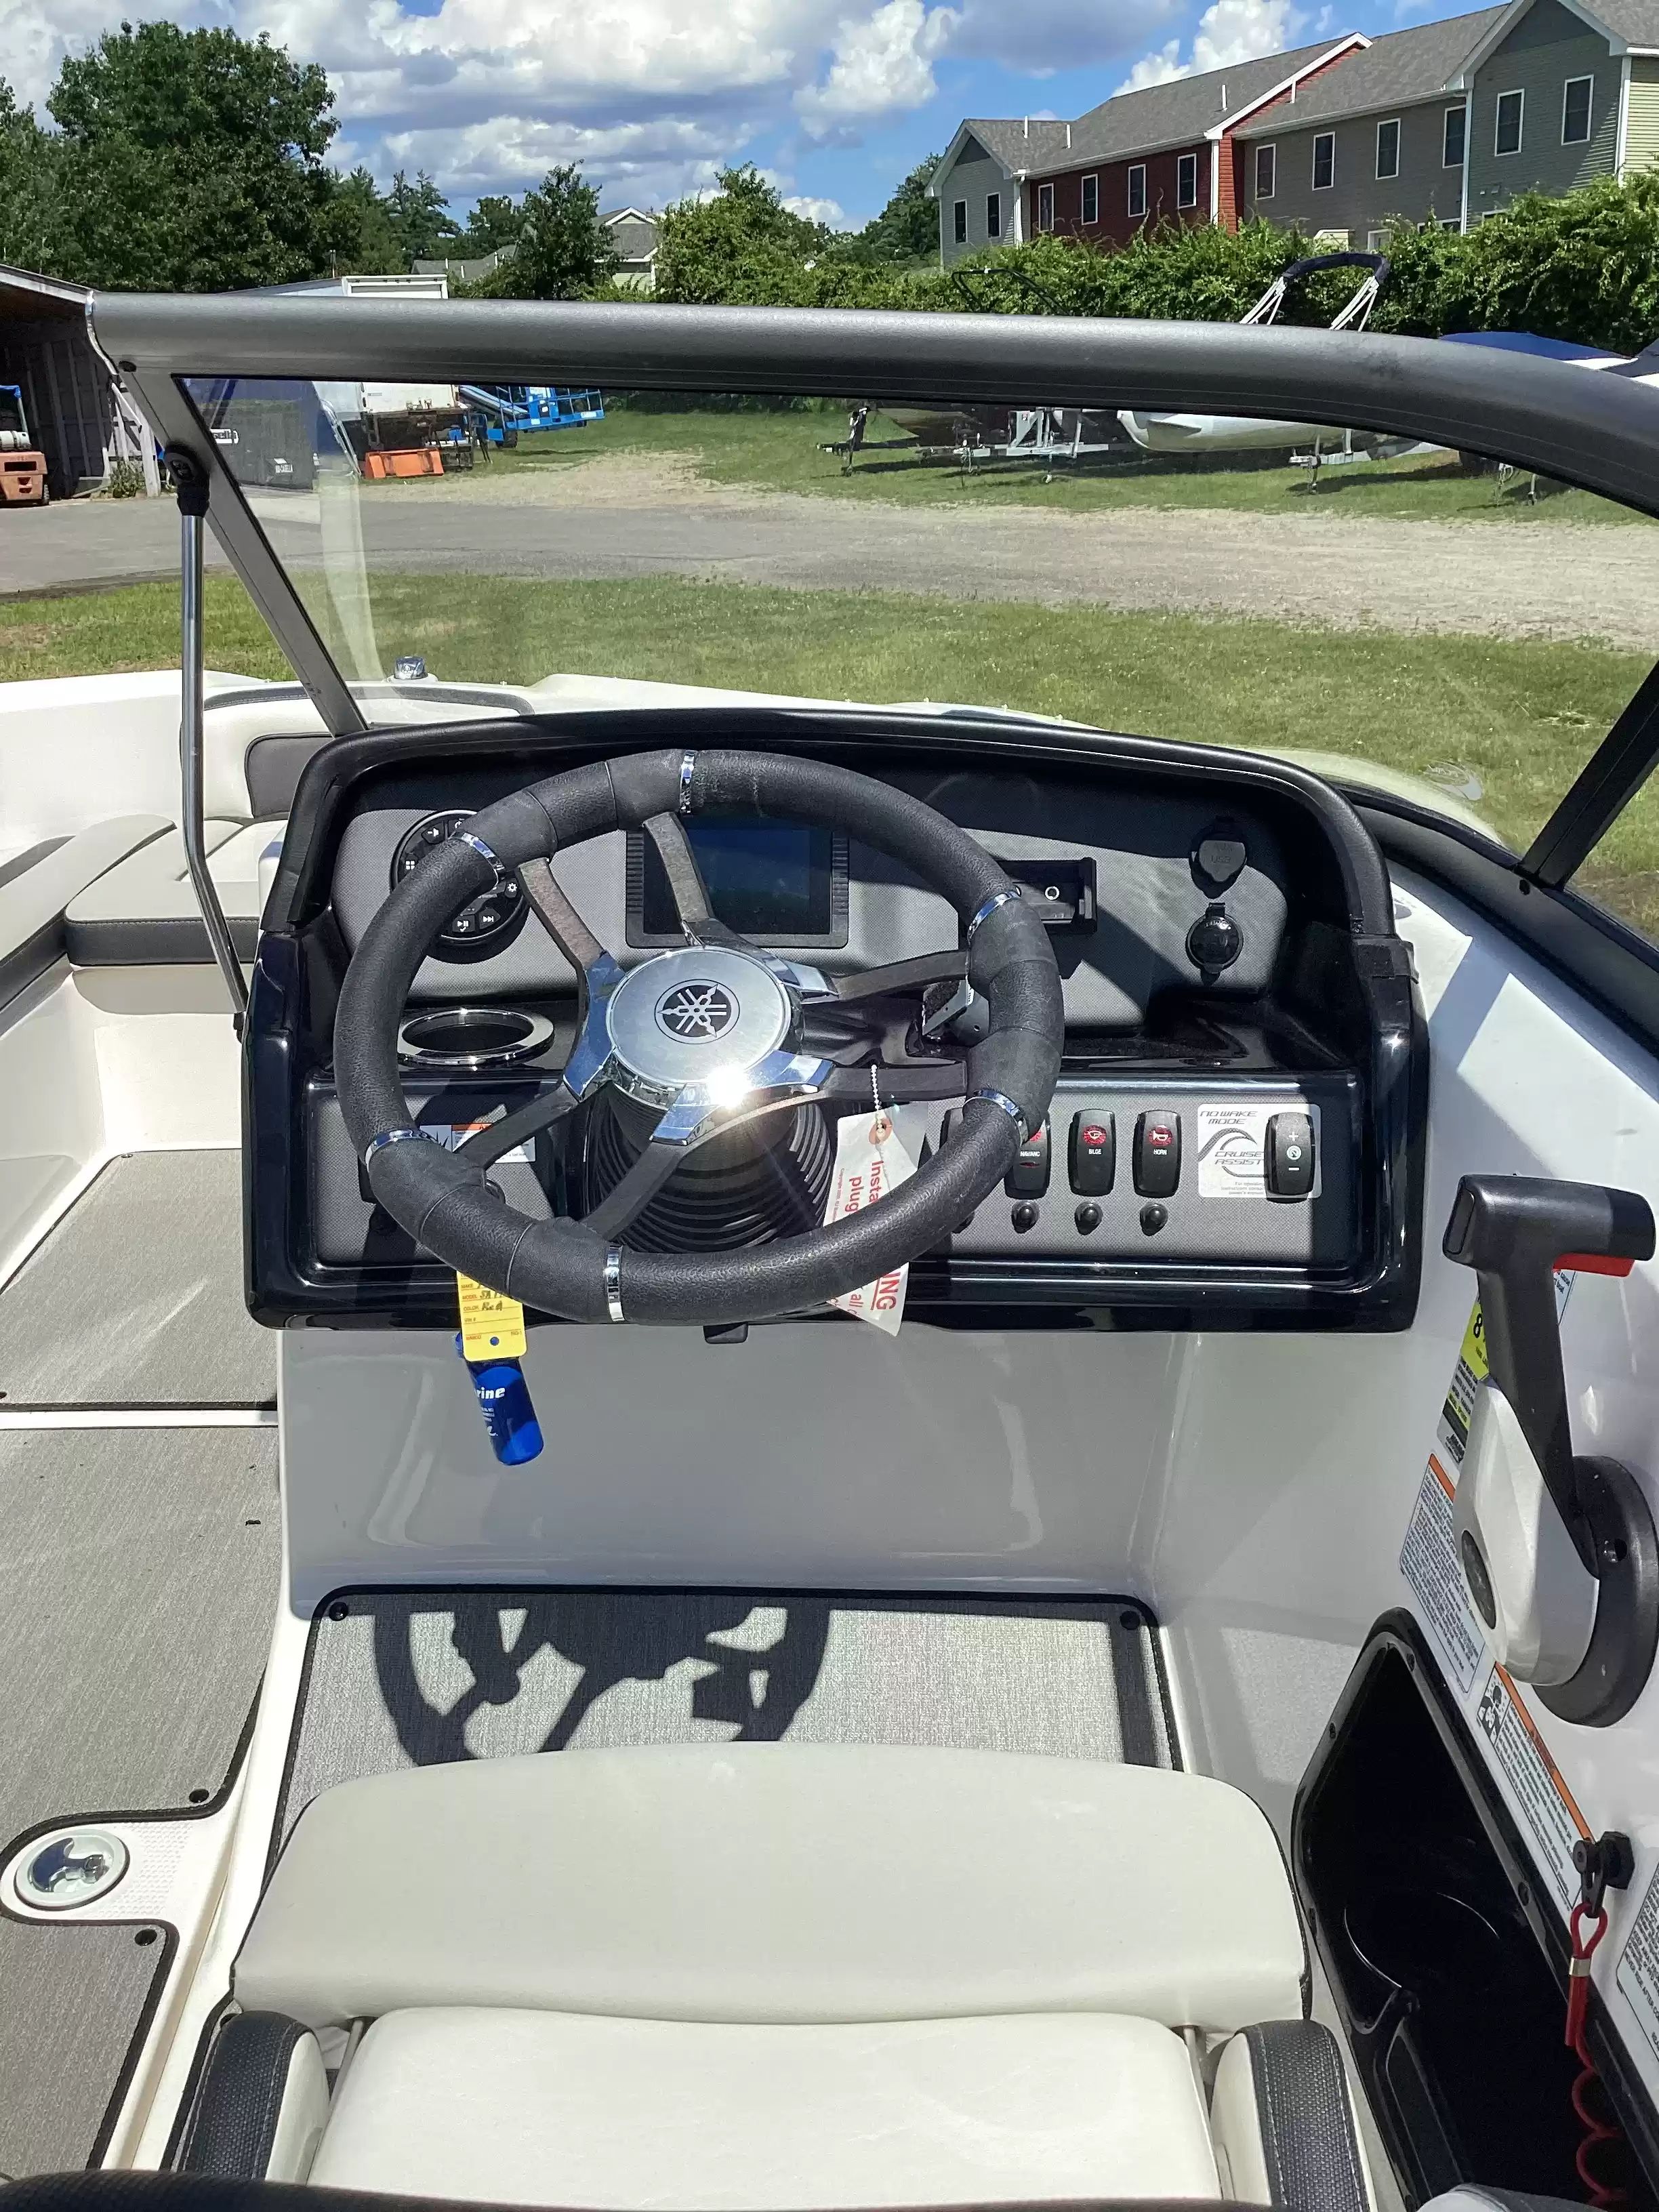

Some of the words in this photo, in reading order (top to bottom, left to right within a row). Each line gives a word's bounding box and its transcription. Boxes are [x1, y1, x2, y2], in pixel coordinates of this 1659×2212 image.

[1210, 855, 1231, 864] USB
[844, 1176, 864, 1212] plug
[869, 1160, 884, 1204] Insta
[876, 1271, 901, 1310] ING
[476, 1387, 506, 1399] rine
